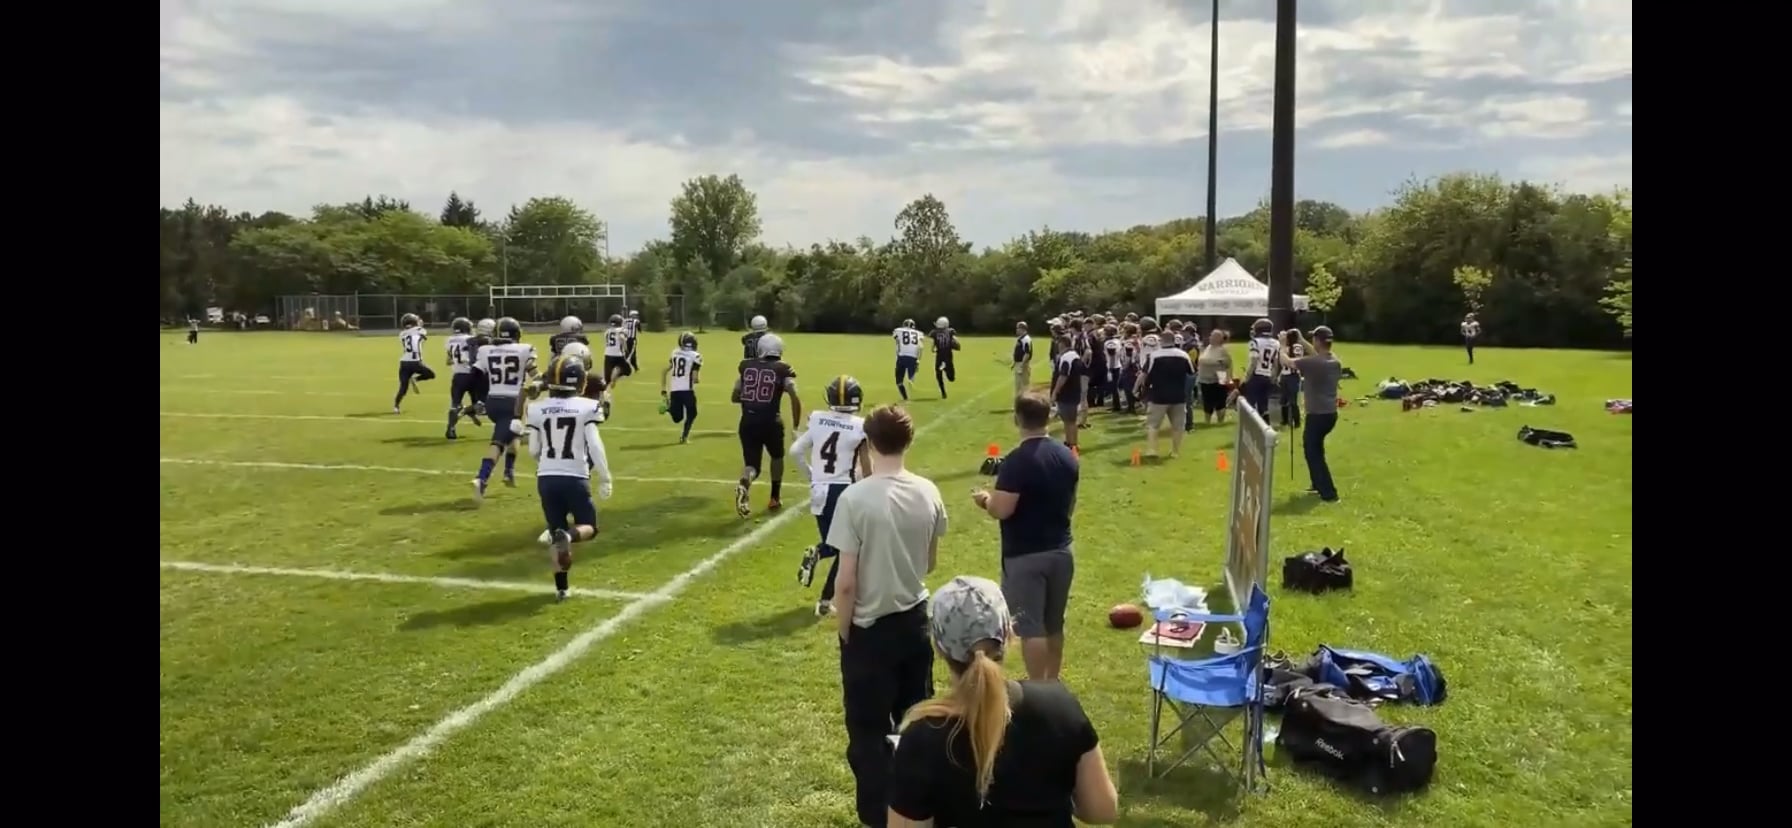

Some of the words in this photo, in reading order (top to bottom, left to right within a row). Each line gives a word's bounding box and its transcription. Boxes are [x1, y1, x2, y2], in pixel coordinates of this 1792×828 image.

[902, 331, 918, 345] 83
[488, 356, 520, 385] 52
[672, 357, 686, 377] 18
[741, 367, 776, 402] 26
[543, 417, 576, 459] 17
[820, 431, 840, 474] 4
